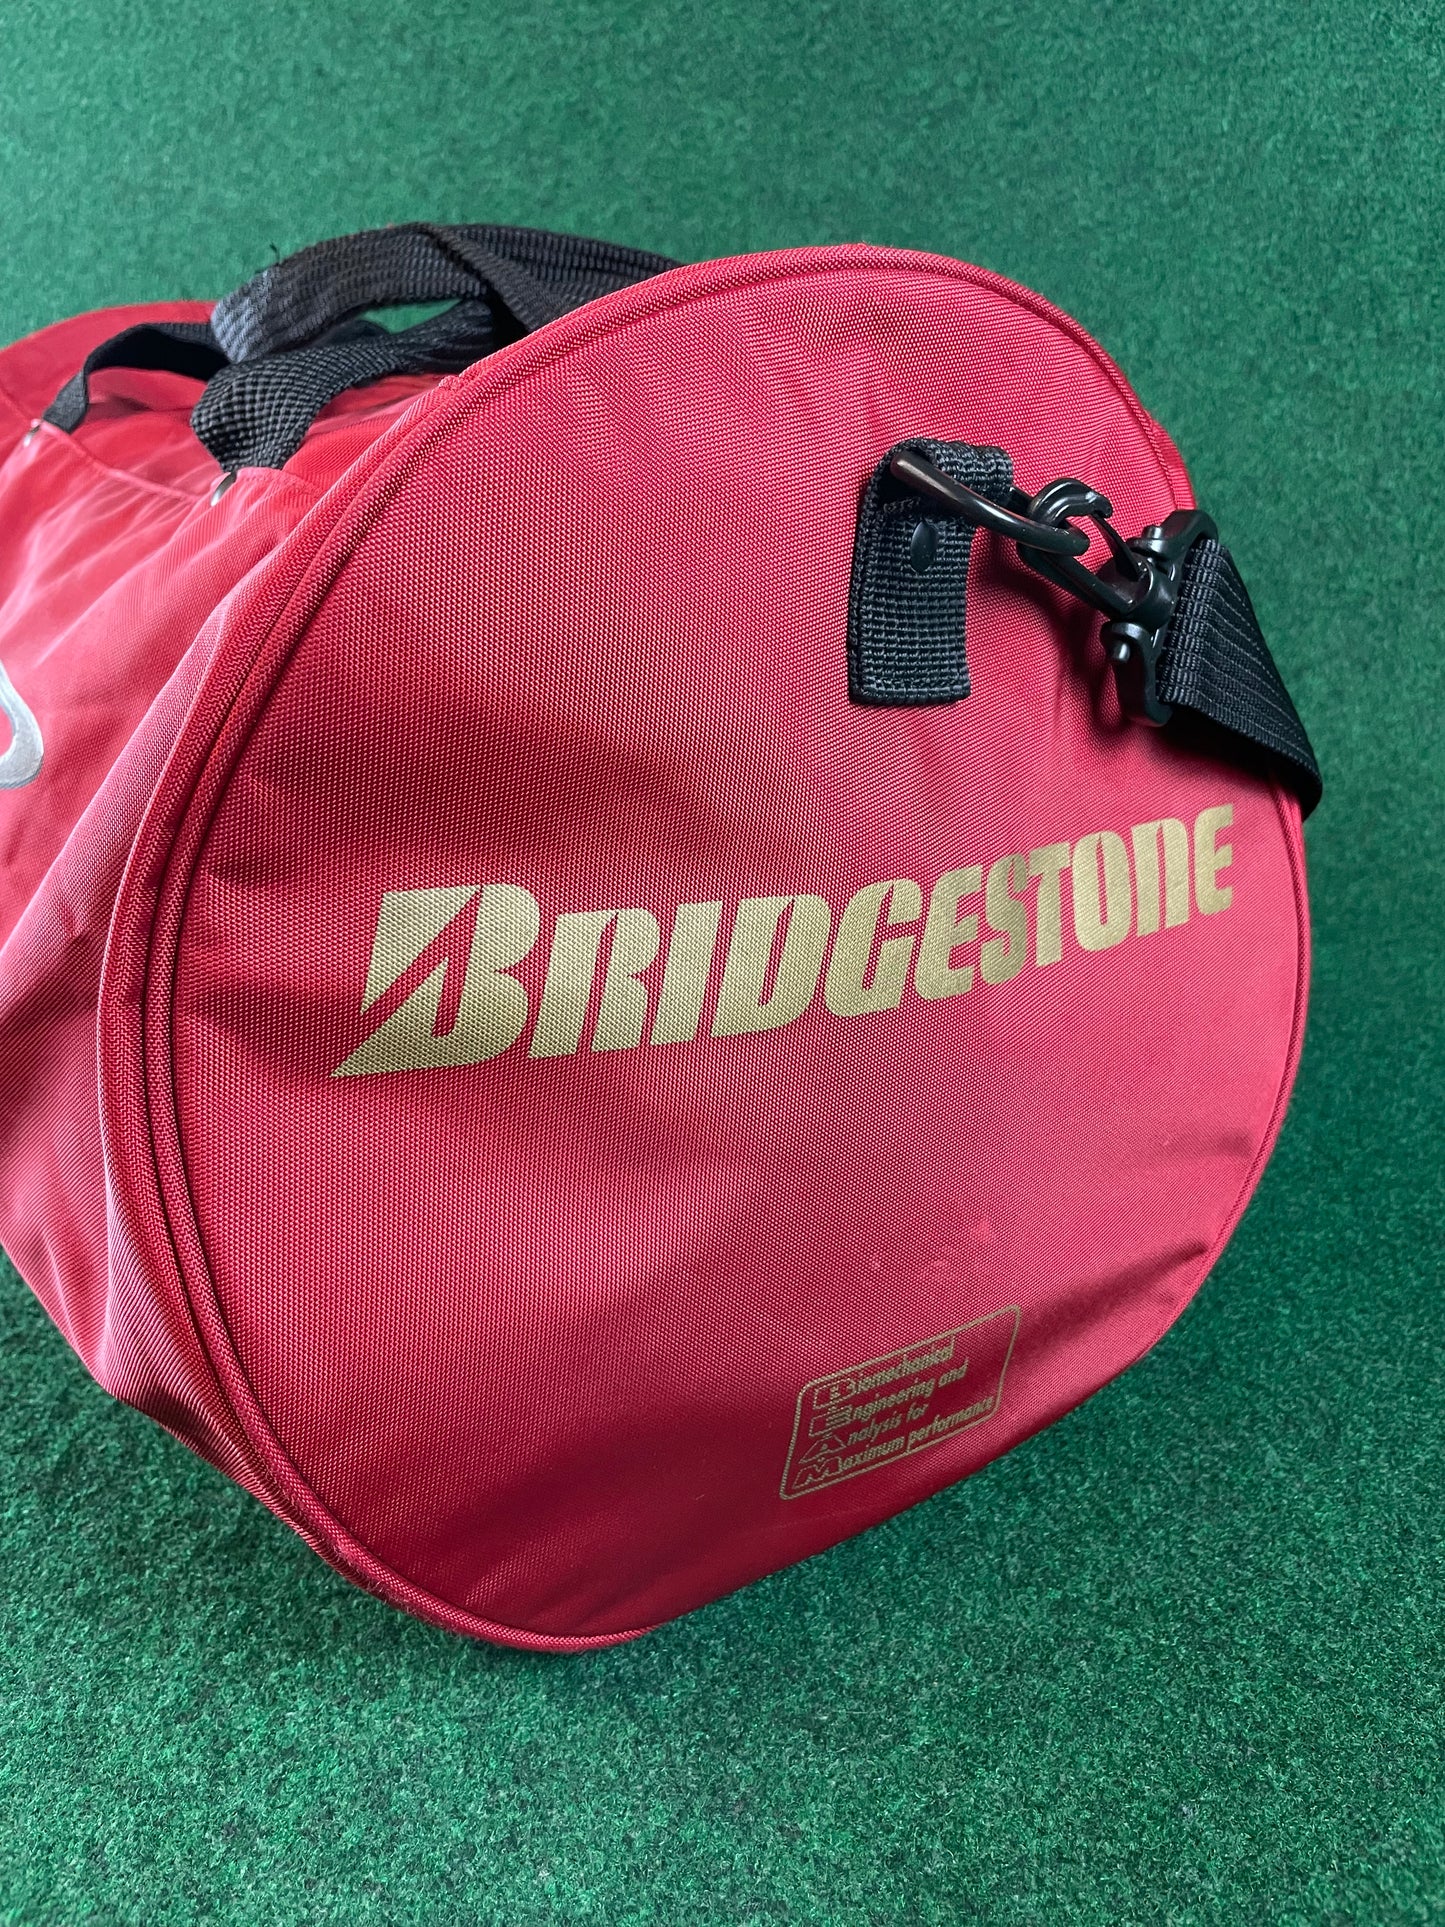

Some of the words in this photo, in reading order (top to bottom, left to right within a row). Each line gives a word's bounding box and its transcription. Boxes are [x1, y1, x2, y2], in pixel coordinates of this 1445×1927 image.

[331, 804, 1235, 1077] BRIDGESTONE
[808, 1378, 935, 1437] Engineering
[938, 1356, 969, 1388] and
[813, 1335, 955, 1410] Biomechanical
[792, 1435, 905, 1490] Maximum
[907, 1396, 993, 1452] performance
[799, 1411, 902, 1464] Analysis
[906, 1402, 929, 1422] for
